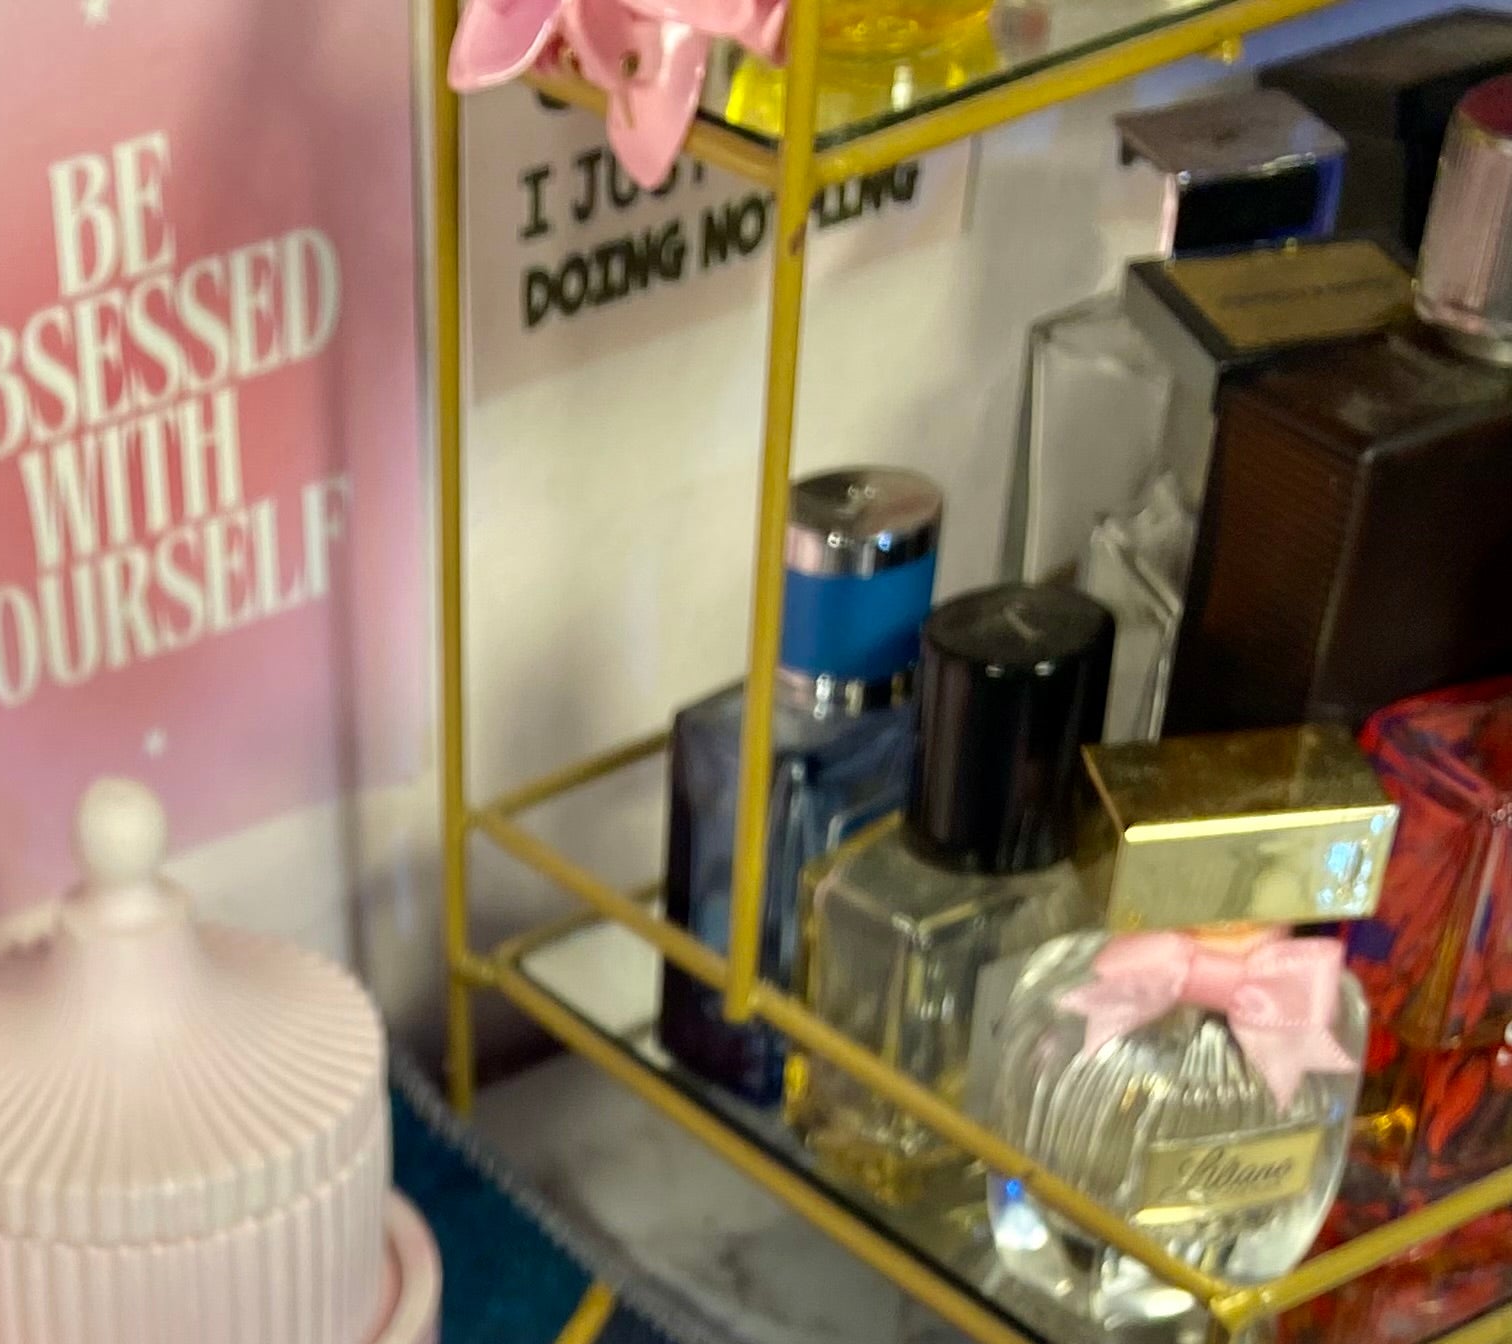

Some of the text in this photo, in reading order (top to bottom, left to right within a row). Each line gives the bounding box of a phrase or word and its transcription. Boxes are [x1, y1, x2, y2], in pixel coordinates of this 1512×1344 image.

[47, 130, 178, 300] BE
[519, 163, 552, 239] I
[524, 160, 919, 330] DOING NOING
[18, 385, 245, 574] WITH
